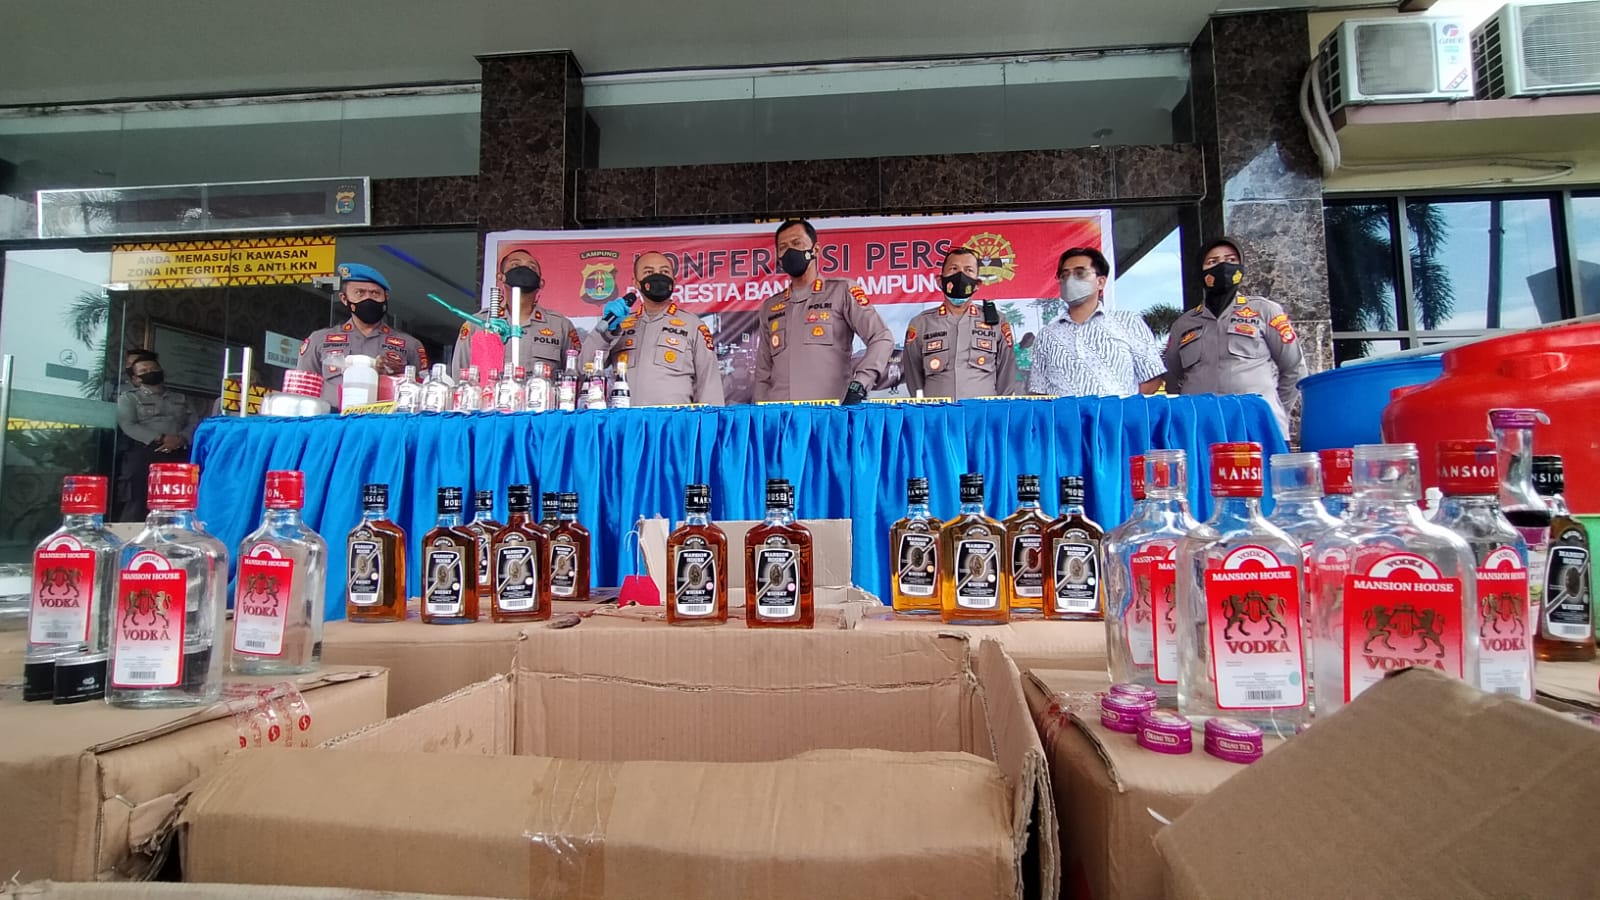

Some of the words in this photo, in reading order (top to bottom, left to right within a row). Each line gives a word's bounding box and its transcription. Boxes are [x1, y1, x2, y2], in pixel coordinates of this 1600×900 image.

[137, 255, 171, 265] ANDA
[174, 252, 243, 264] MEMASUKI
[246, 249, 309, 261] KAWASAN
[580, 250, 619, 260] LAMPUNG
[866, 239, 953, 272] PERS
[128, 268, 161, 278] ZONA
[165, 264, 240, 276] INTEGRITAS
[244, 264, 252, 273] &
[257, 262, 287, 272] ANTI
[290, 260, 318, 270] KKN
[808, 302, 832, 310] POLRI
[1230, 318, 1260, 326] POLRI
[662, 326, 688, 337] POLRI
[972, 330, 996, 338] POLRI
[534, 336, 560, 346] POLRI
[1212, 572, 1258, 582] MANSION
[1260, 571, 1292, 580] HOUSE
[1354, 580, 1412, 592] MANSION
[1414, 582, 1455, 592] HOUSE
[40, 598, 80, 608] VODKA
[242, 604, 279, 617] VODKA
[123, 629, 171, 641] VODKA
[1226, 639, 1292, 654] VODKA
[1480, 638, 1527, 652] VODKA
